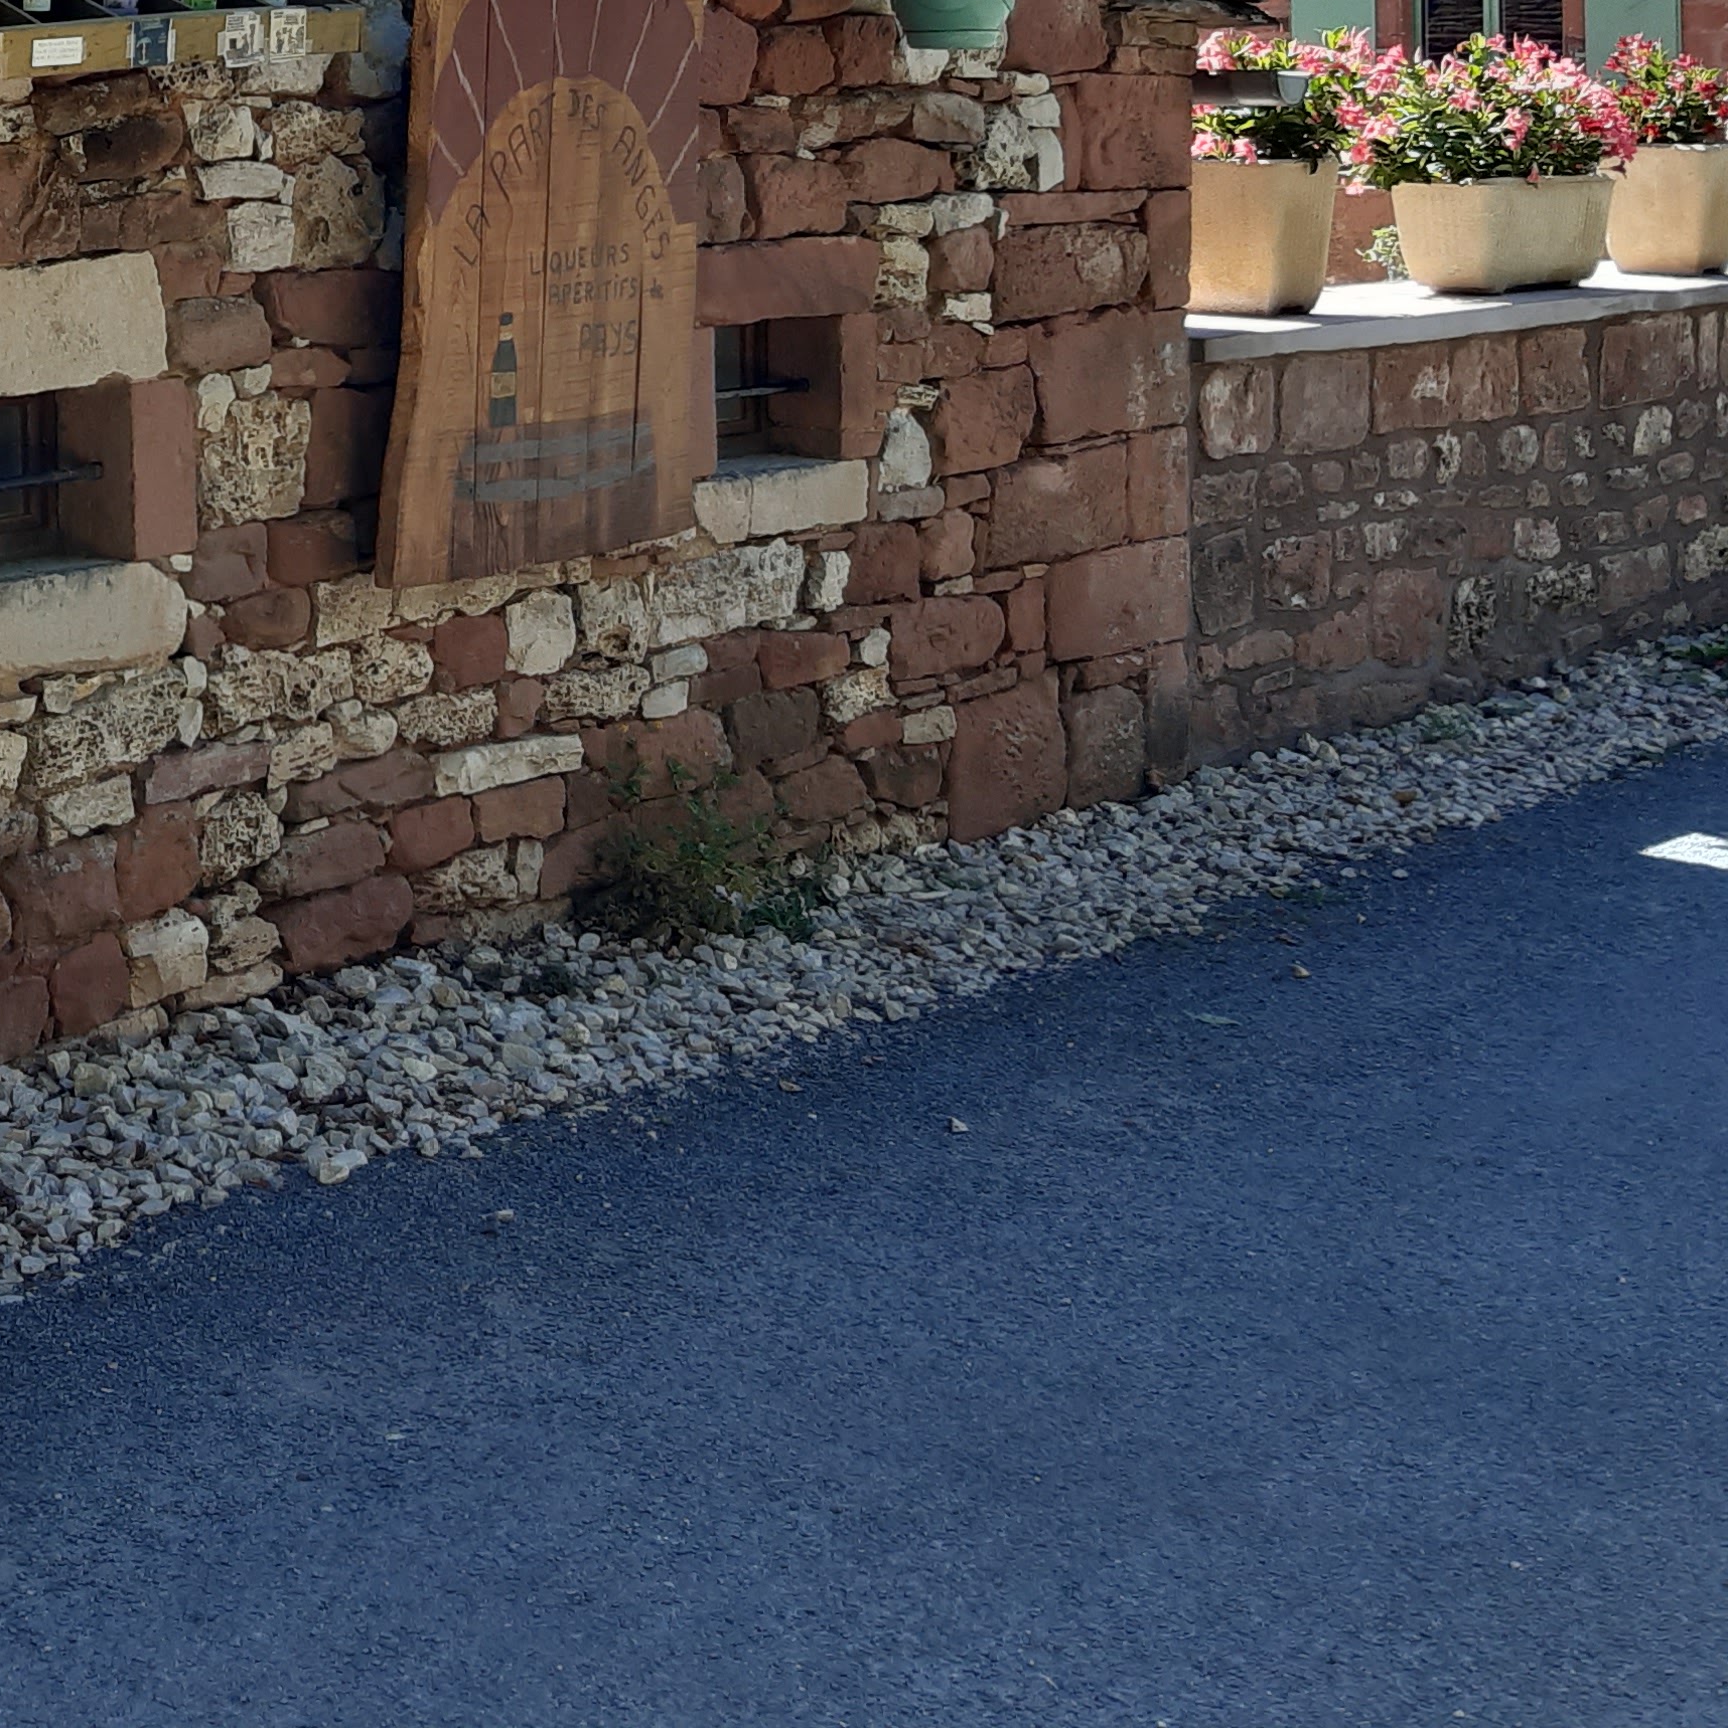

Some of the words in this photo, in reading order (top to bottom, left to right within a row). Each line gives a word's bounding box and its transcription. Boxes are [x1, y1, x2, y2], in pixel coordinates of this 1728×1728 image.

[453, 203, 491, 267] LA
[490, 91, 556, 203] PART
[568, 88, 607, 131] DES
[612, 125, 670, 261] ANGES
[528, 242, 629, 276] LIQUEURS
[578, 320, 639, 360] PAYS
